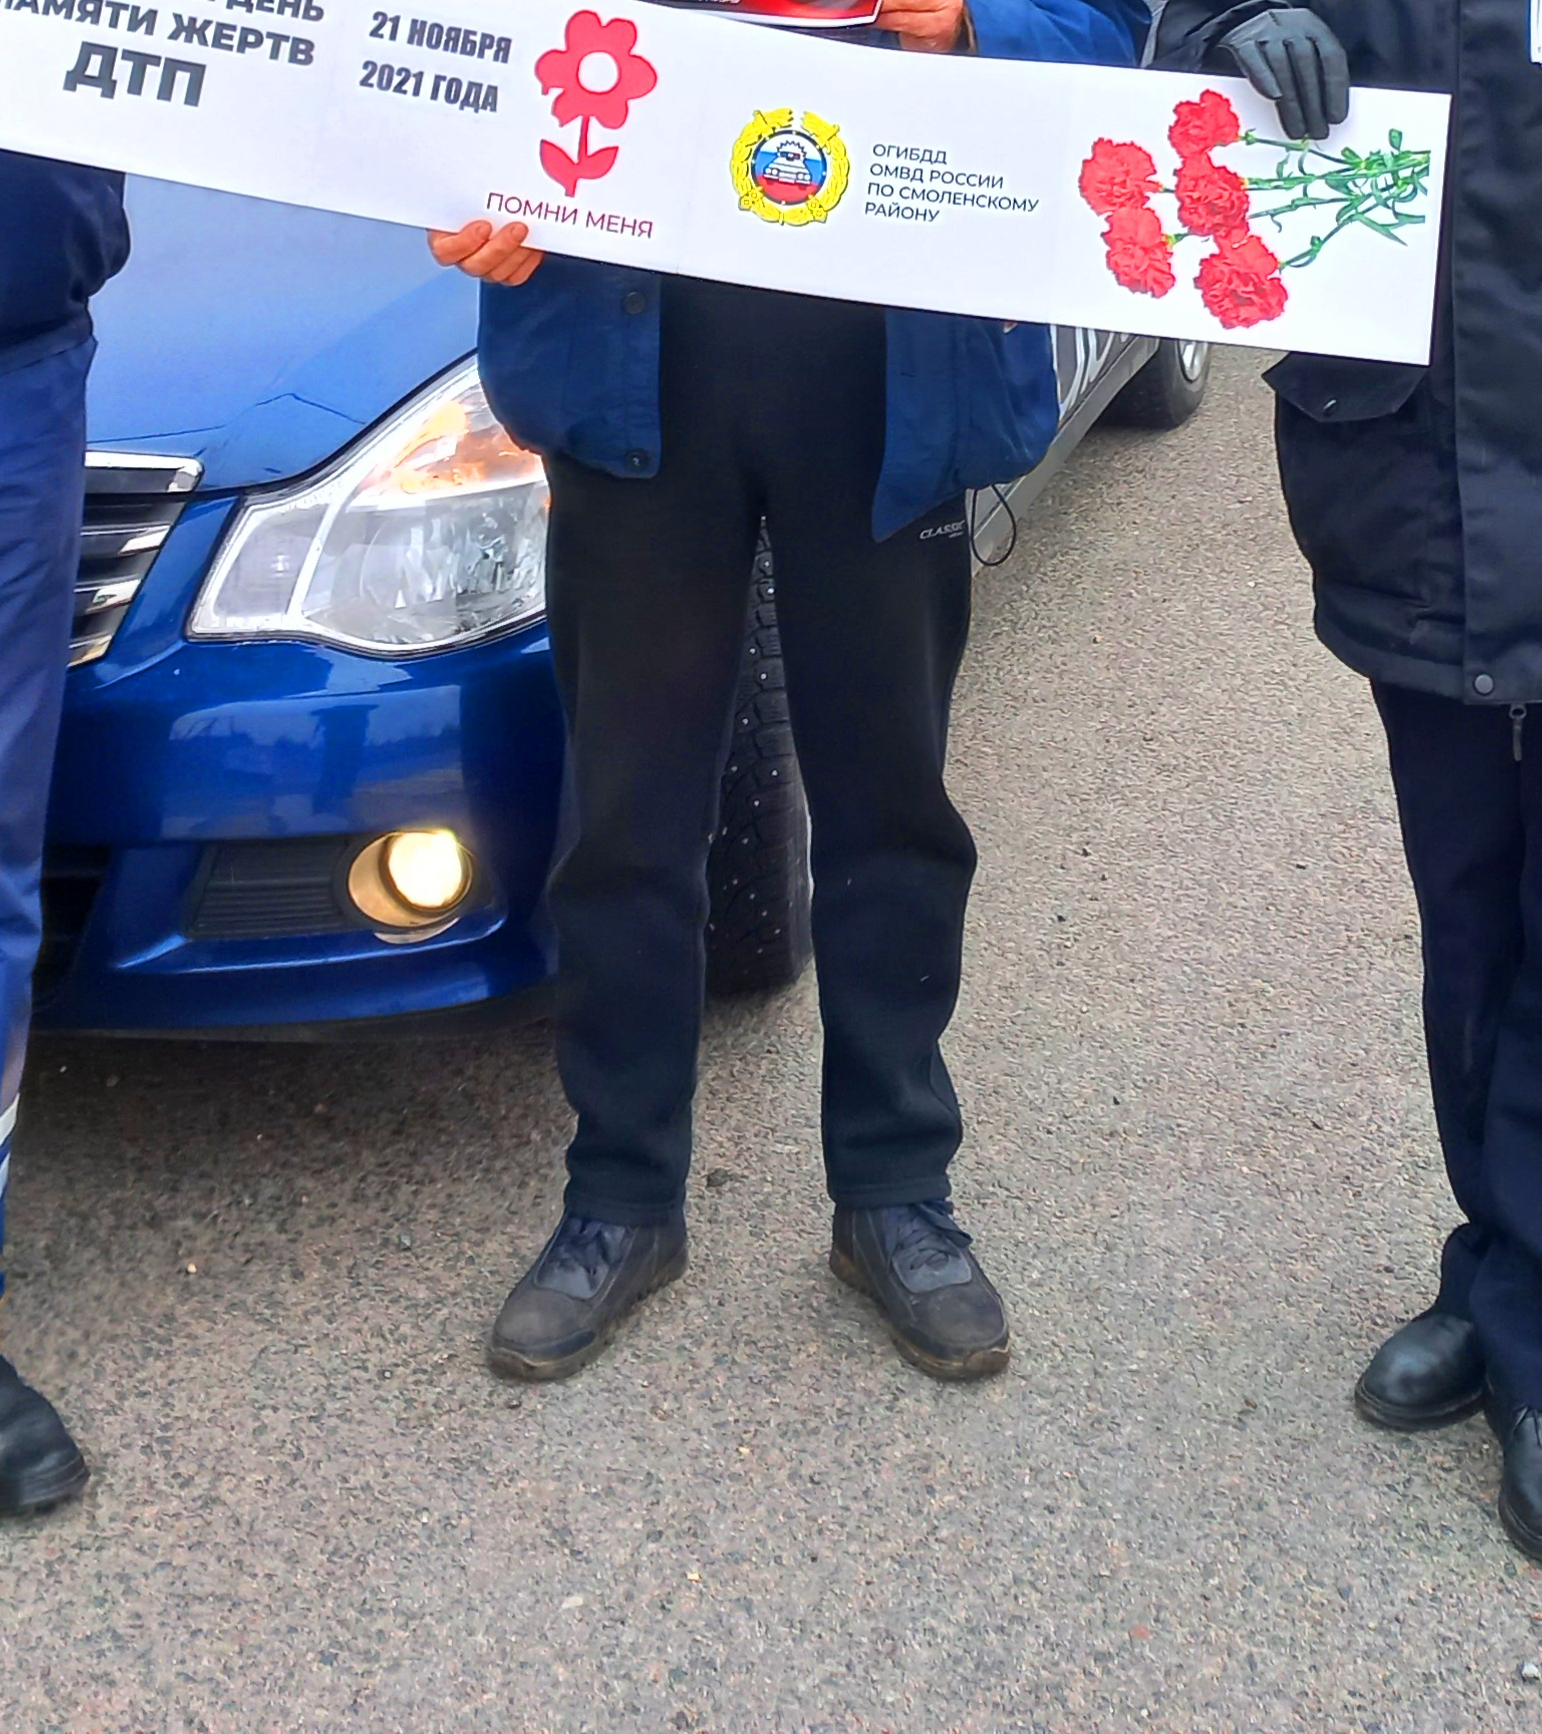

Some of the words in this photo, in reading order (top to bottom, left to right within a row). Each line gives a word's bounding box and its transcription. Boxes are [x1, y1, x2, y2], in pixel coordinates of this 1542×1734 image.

[167, 12, 316, 67] ЖЕРТВ
[368, 10, 401, 42] 21
[406, 18, 513, 64] НОЯБРЯ
[62, 41, 207, 108] ДТП
[359, 60, 425, 97] 2021
[429, 74, 499, 114] ГОДА
[869, 163, 925, 184] ОМВД
[929, 170, 1004, 190] РОССИИ
[872, 143, 948, 166] ОГИБДД
[486, 192, 579, 225] ПОМНИ
[585, 211, 654, 239] МЕНЯ
[864, 201, 940, 223] РАЙОНУ
[867, 182, 894, 197] ПО
[898, 186, 1040, 213] СМОЛЕНСКОМУ
